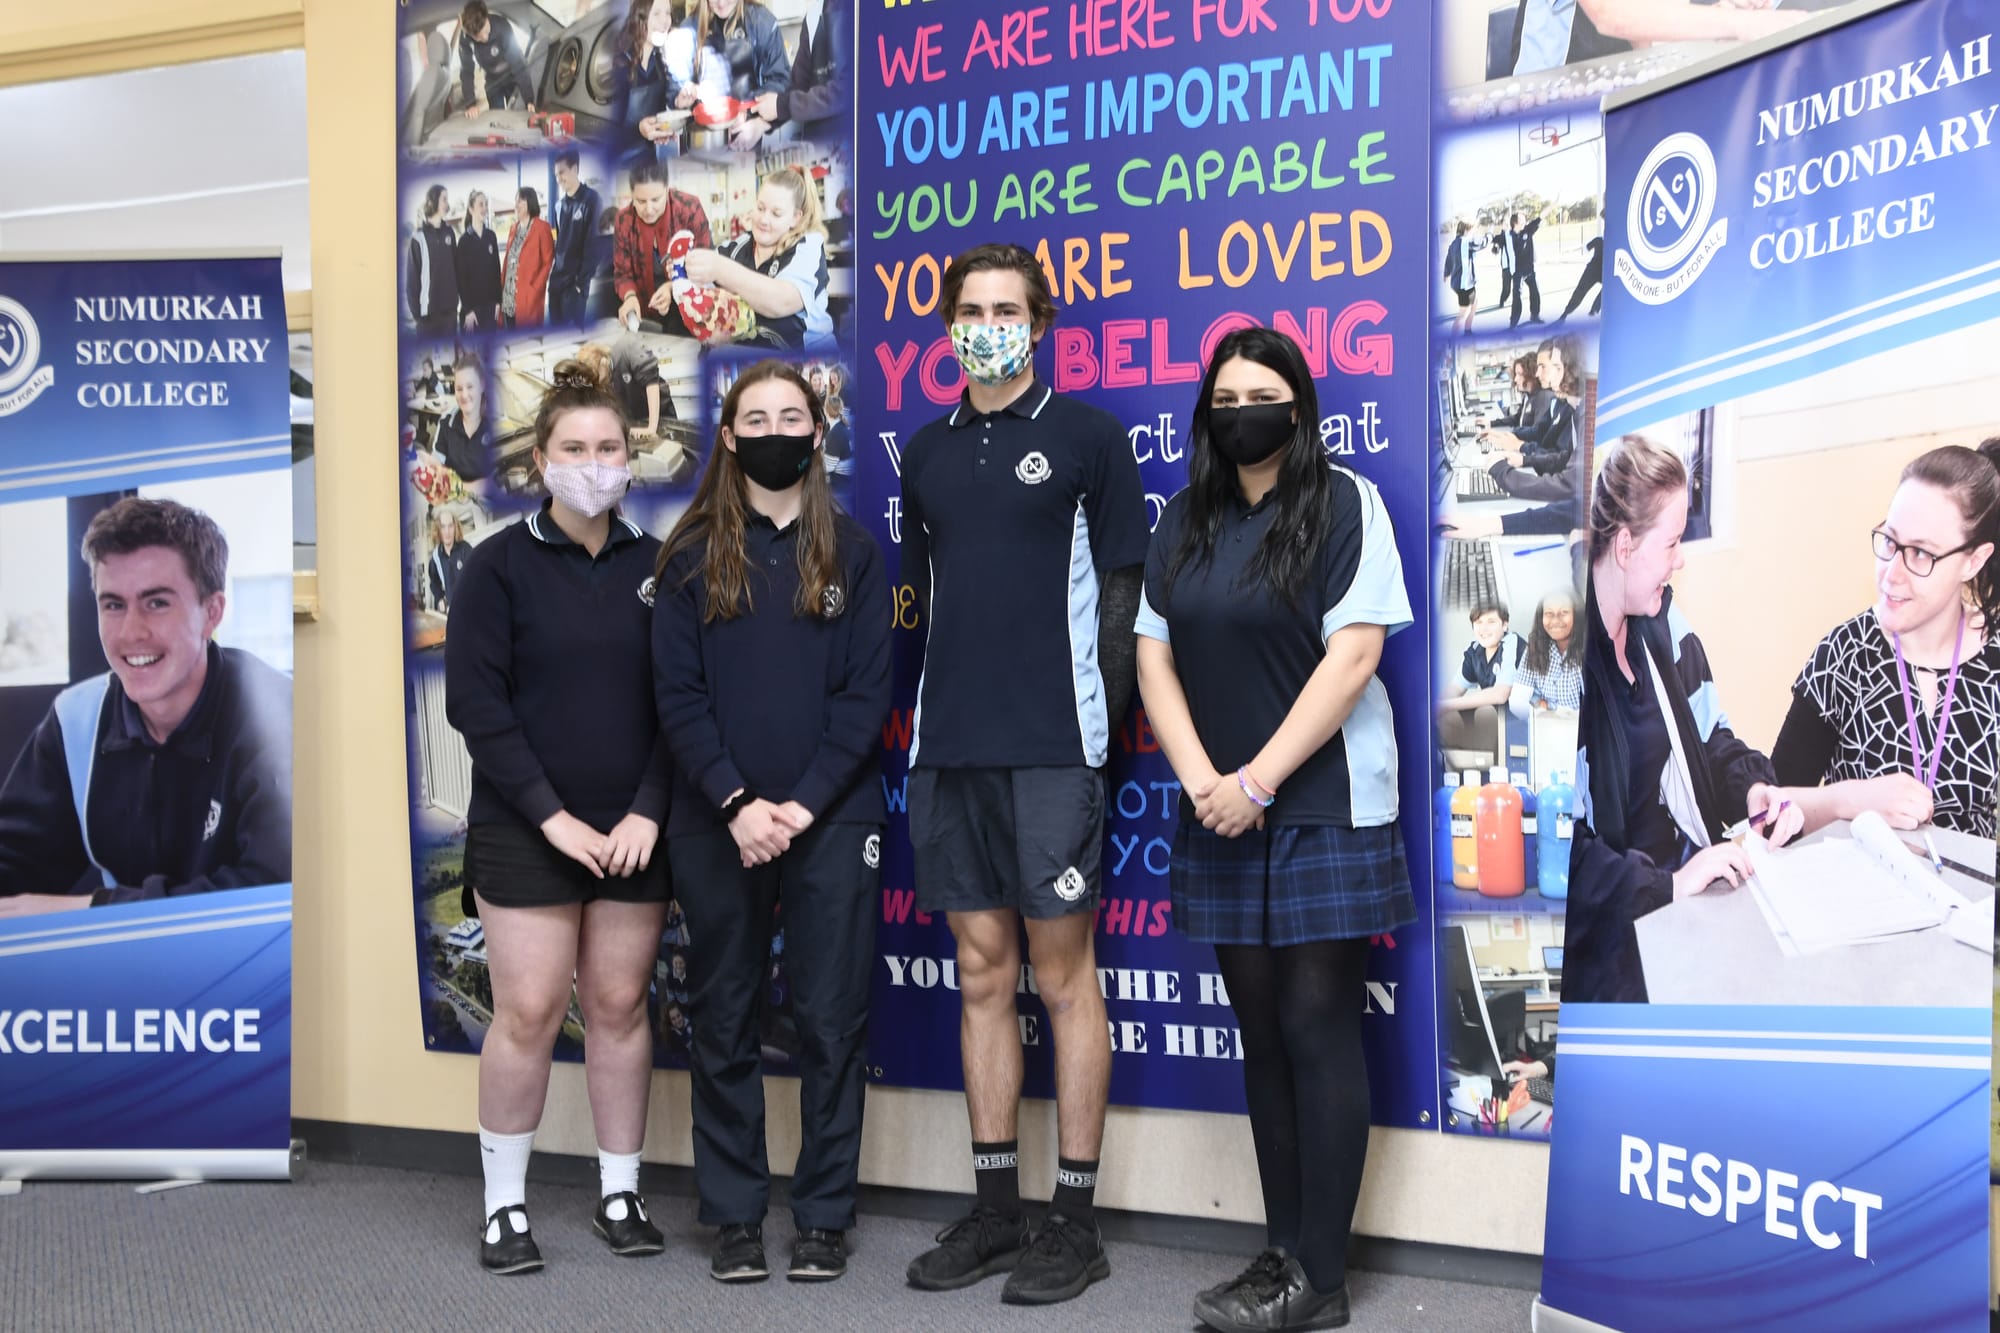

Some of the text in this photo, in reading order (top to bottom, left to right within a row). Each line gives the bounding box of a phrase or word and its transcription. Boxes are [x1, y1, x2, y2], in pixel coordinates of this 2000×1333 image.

[878, 23, 946, 87] WE
[962, 6, 1052, 72] ARE
[1069, 0, 1175, 59] HERE
[876, 44, 1393, 167] YOU ARE IMPORTANT
[1756, 34, 1992, 146] NUMURKAH
[873, 130, 1396, 239] YOU ARE CAPABLE
[1753, 105, 2000, 208] SECONDARY
[874, 252, 952, 321] YO
[1178, 209, 1393, 289] LOVED
[1643, 286, 1660, 296] ONE
[1666, 274, 1684, 293] BUT
[1686, 254, 1704, 278] FOR
[1705, 232, 1722, 253] ALL
[1750, 193, 1935, 270] COLLEGE
[74, 296, 264, 323] NUMURKAH
[76, 338, 271, 365] SECONDARY
[874, 335, 968, 411] YO
[77, 381, 229, 408] COLLEGE
[1105, 780, 1181, 819] OT
[1096, 967, 1181, 1003] THE
[1619, 1133, 1883, 1260] RESPECT
